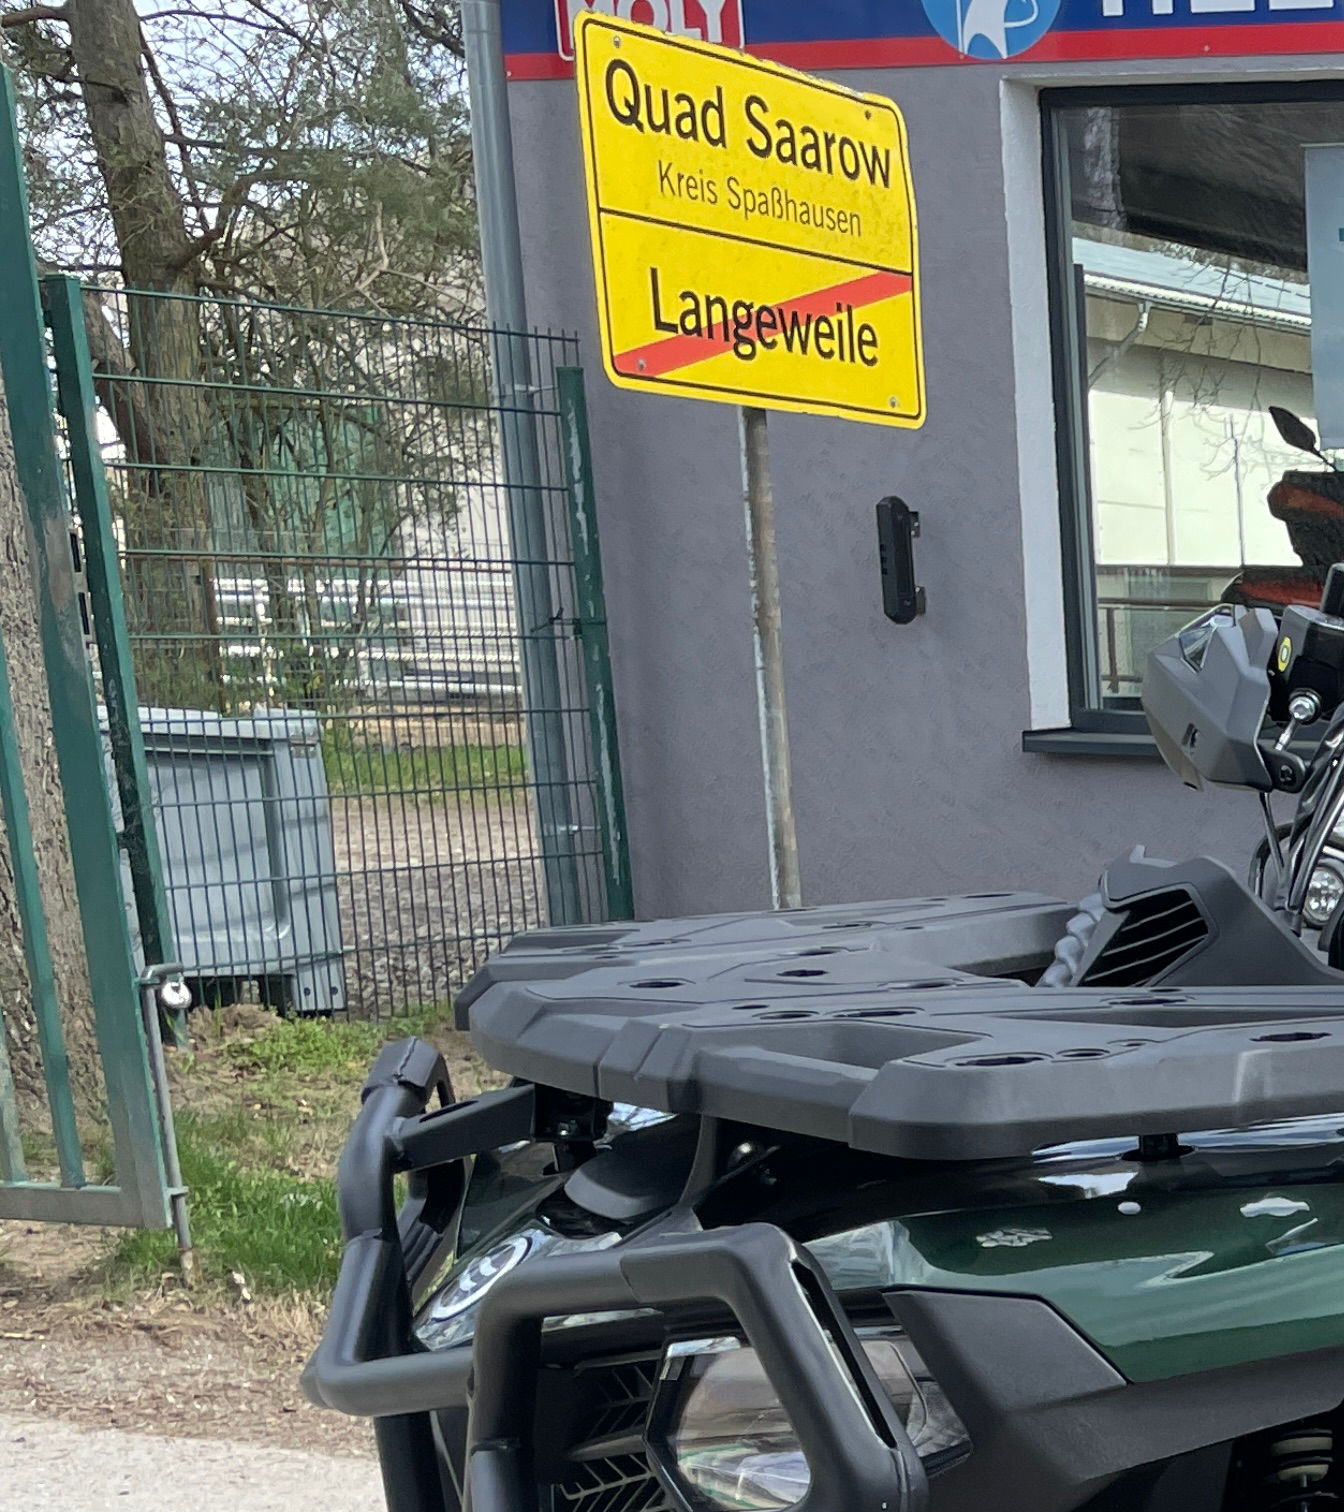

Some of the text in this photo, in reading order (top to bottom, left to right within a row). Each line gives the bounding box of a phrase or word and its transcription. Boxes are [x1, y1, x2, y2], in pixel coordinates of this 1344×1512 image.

[566, 0, 729, 43] OLY
[604, 58, 892, 189] Quad Saarow
[657, 160, 862, 238] Kreis Spaßhausen
[649, 267, 879, 368] Langeweile
